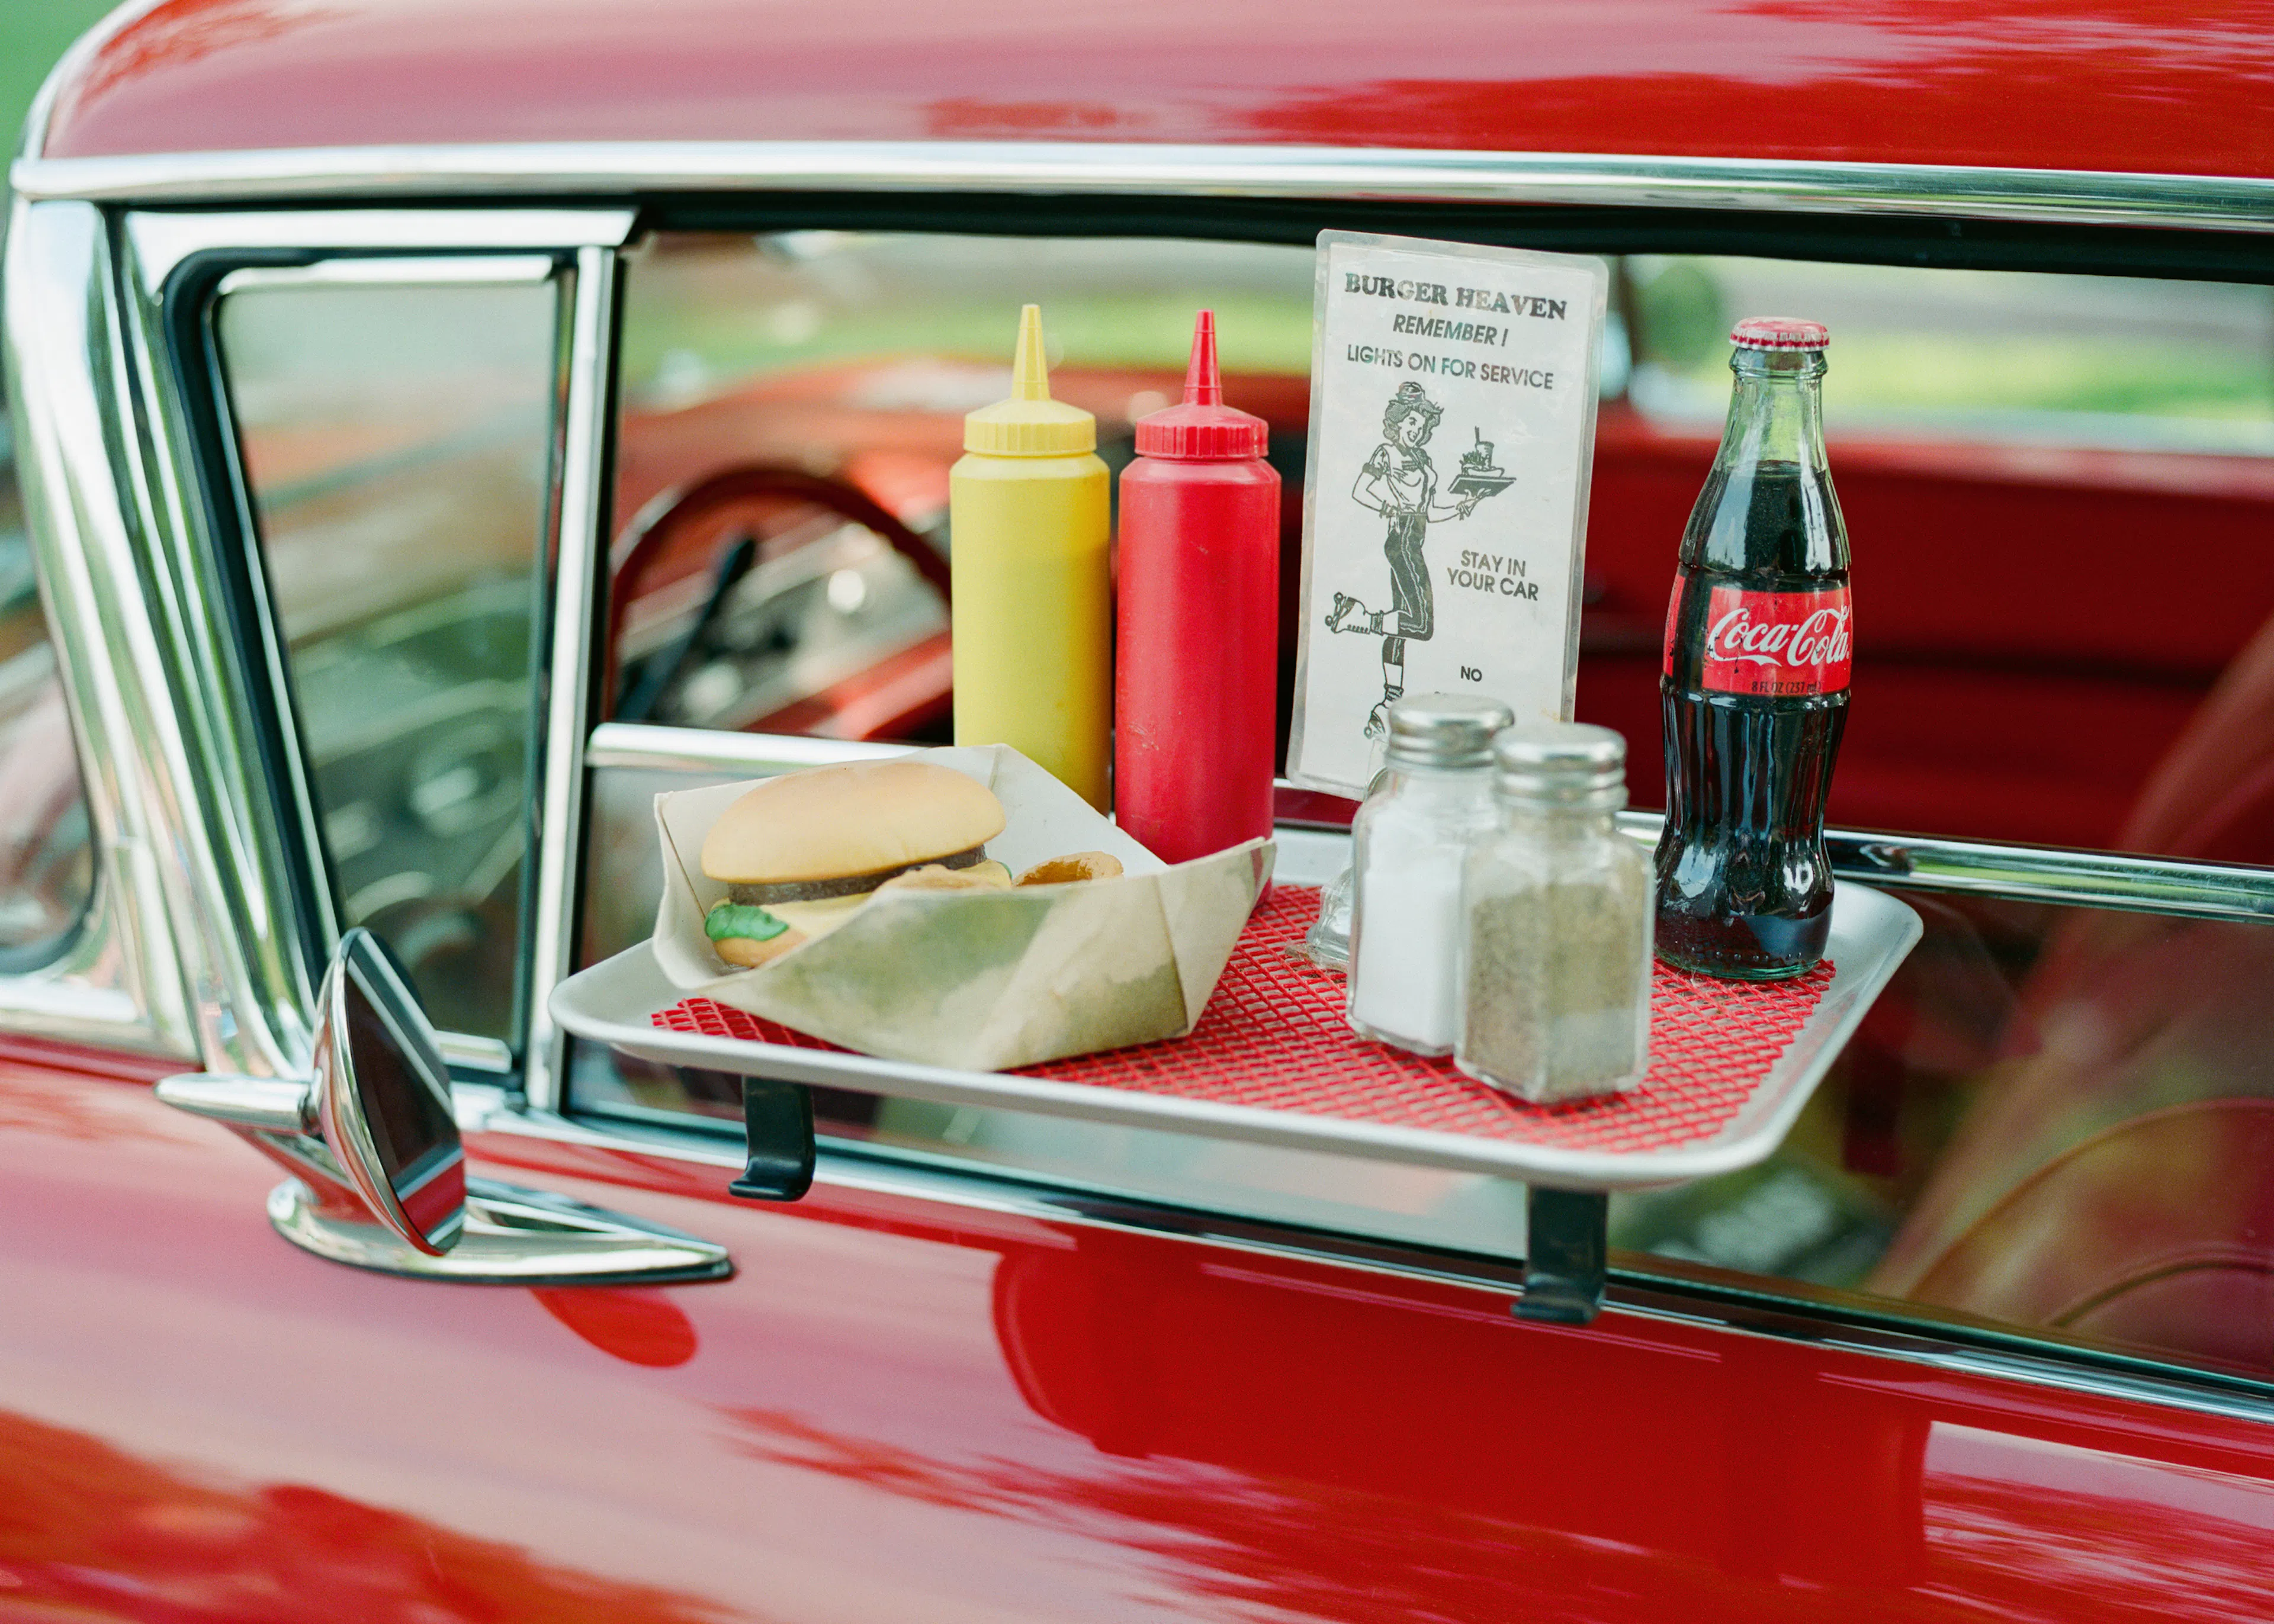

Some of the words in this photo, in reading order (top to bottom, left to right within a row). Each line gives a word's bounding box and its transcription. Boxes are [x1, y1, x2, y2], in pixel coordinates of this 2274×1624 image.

[1344, 272, 1448, 306] BURGER
[1456, 287, 1568, 320] HEAVEN
[1393, 314, 1497, 345] REMEMBER
[1347, 345, 1403, 368] LIGHTS
[1408, 353, 1435, 373] ON
[1441, 358, 1476, 379] FOR
[1481, 364, 1554, 390] SERVICE
[1460, 550, 1504, 573] STAY
[1508, 558, 1526, 577] IN
[1447, 567, 1495, 593] YOUR
[1500, 578, 1539, 602] CAR
[1708, 605, 1850, 667] Coca-Cola
[1460, 666, 1482, 682] NO
[1752, 681, 1758, 692] 8
[1759, 681, 1769, 692] FL
[1771, 681, 1784, 693] OZ
[1785, 681, 1805, 694] (237
